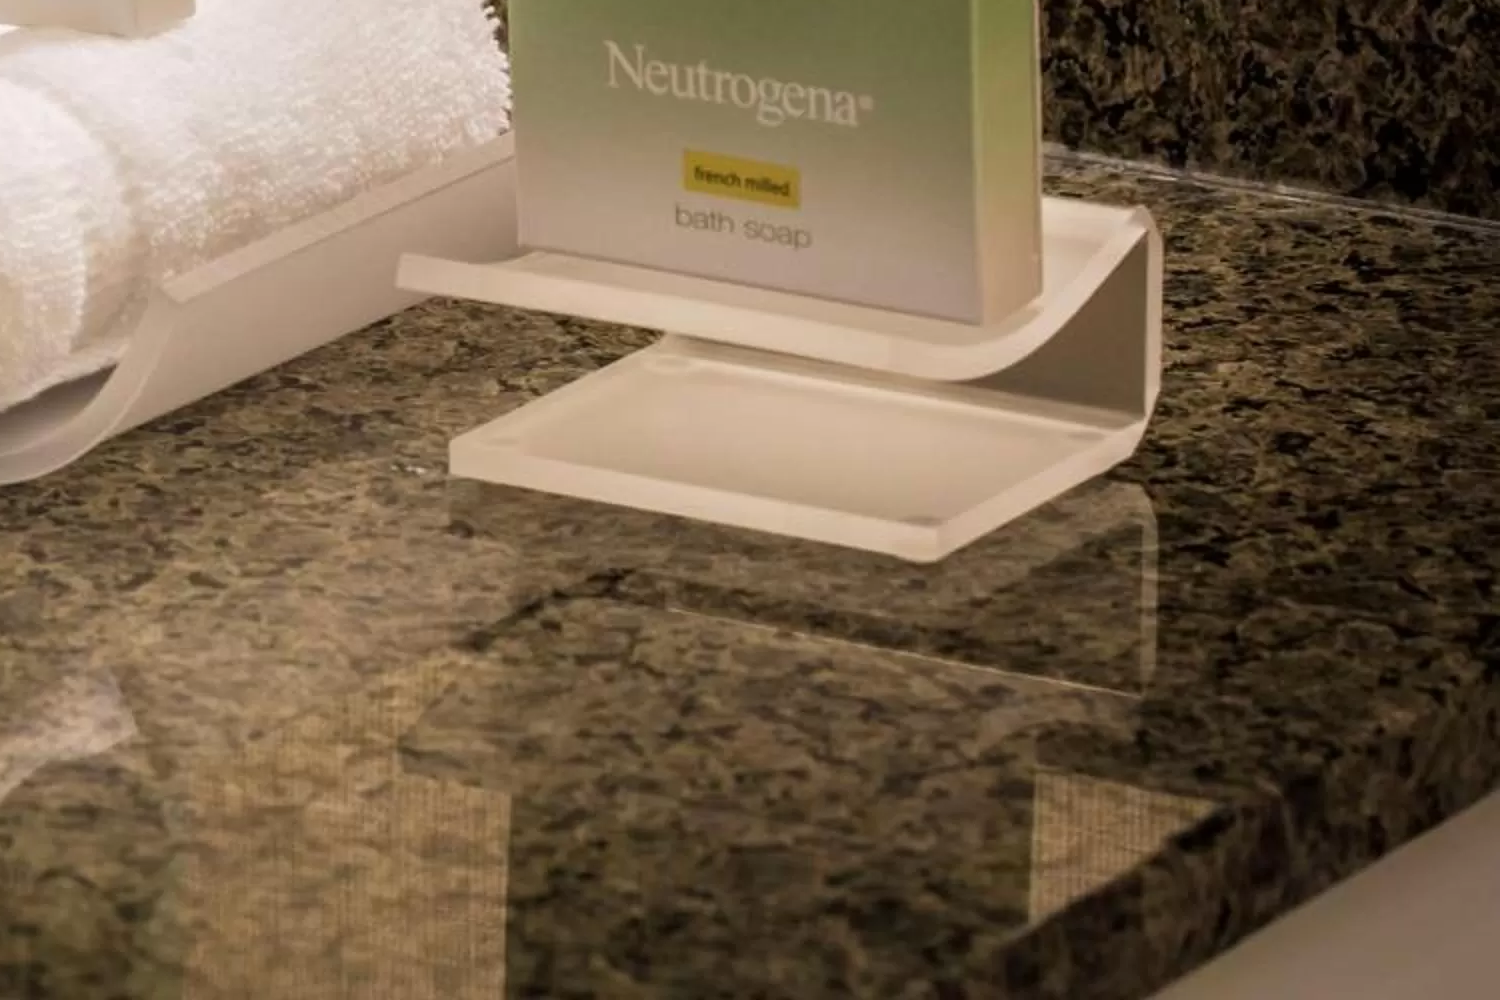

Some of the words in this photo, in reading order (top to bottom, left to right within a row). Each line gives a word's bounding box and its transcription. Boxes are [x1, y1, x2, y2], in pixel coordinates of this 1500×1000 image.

[603, 39, 859, 128] Neutrogena
[694, 165, 741, 190] french
[745, 176, 790, 198] milled
[674, 202, 735, 234] bath
[743, 218, 813, 250] soap
